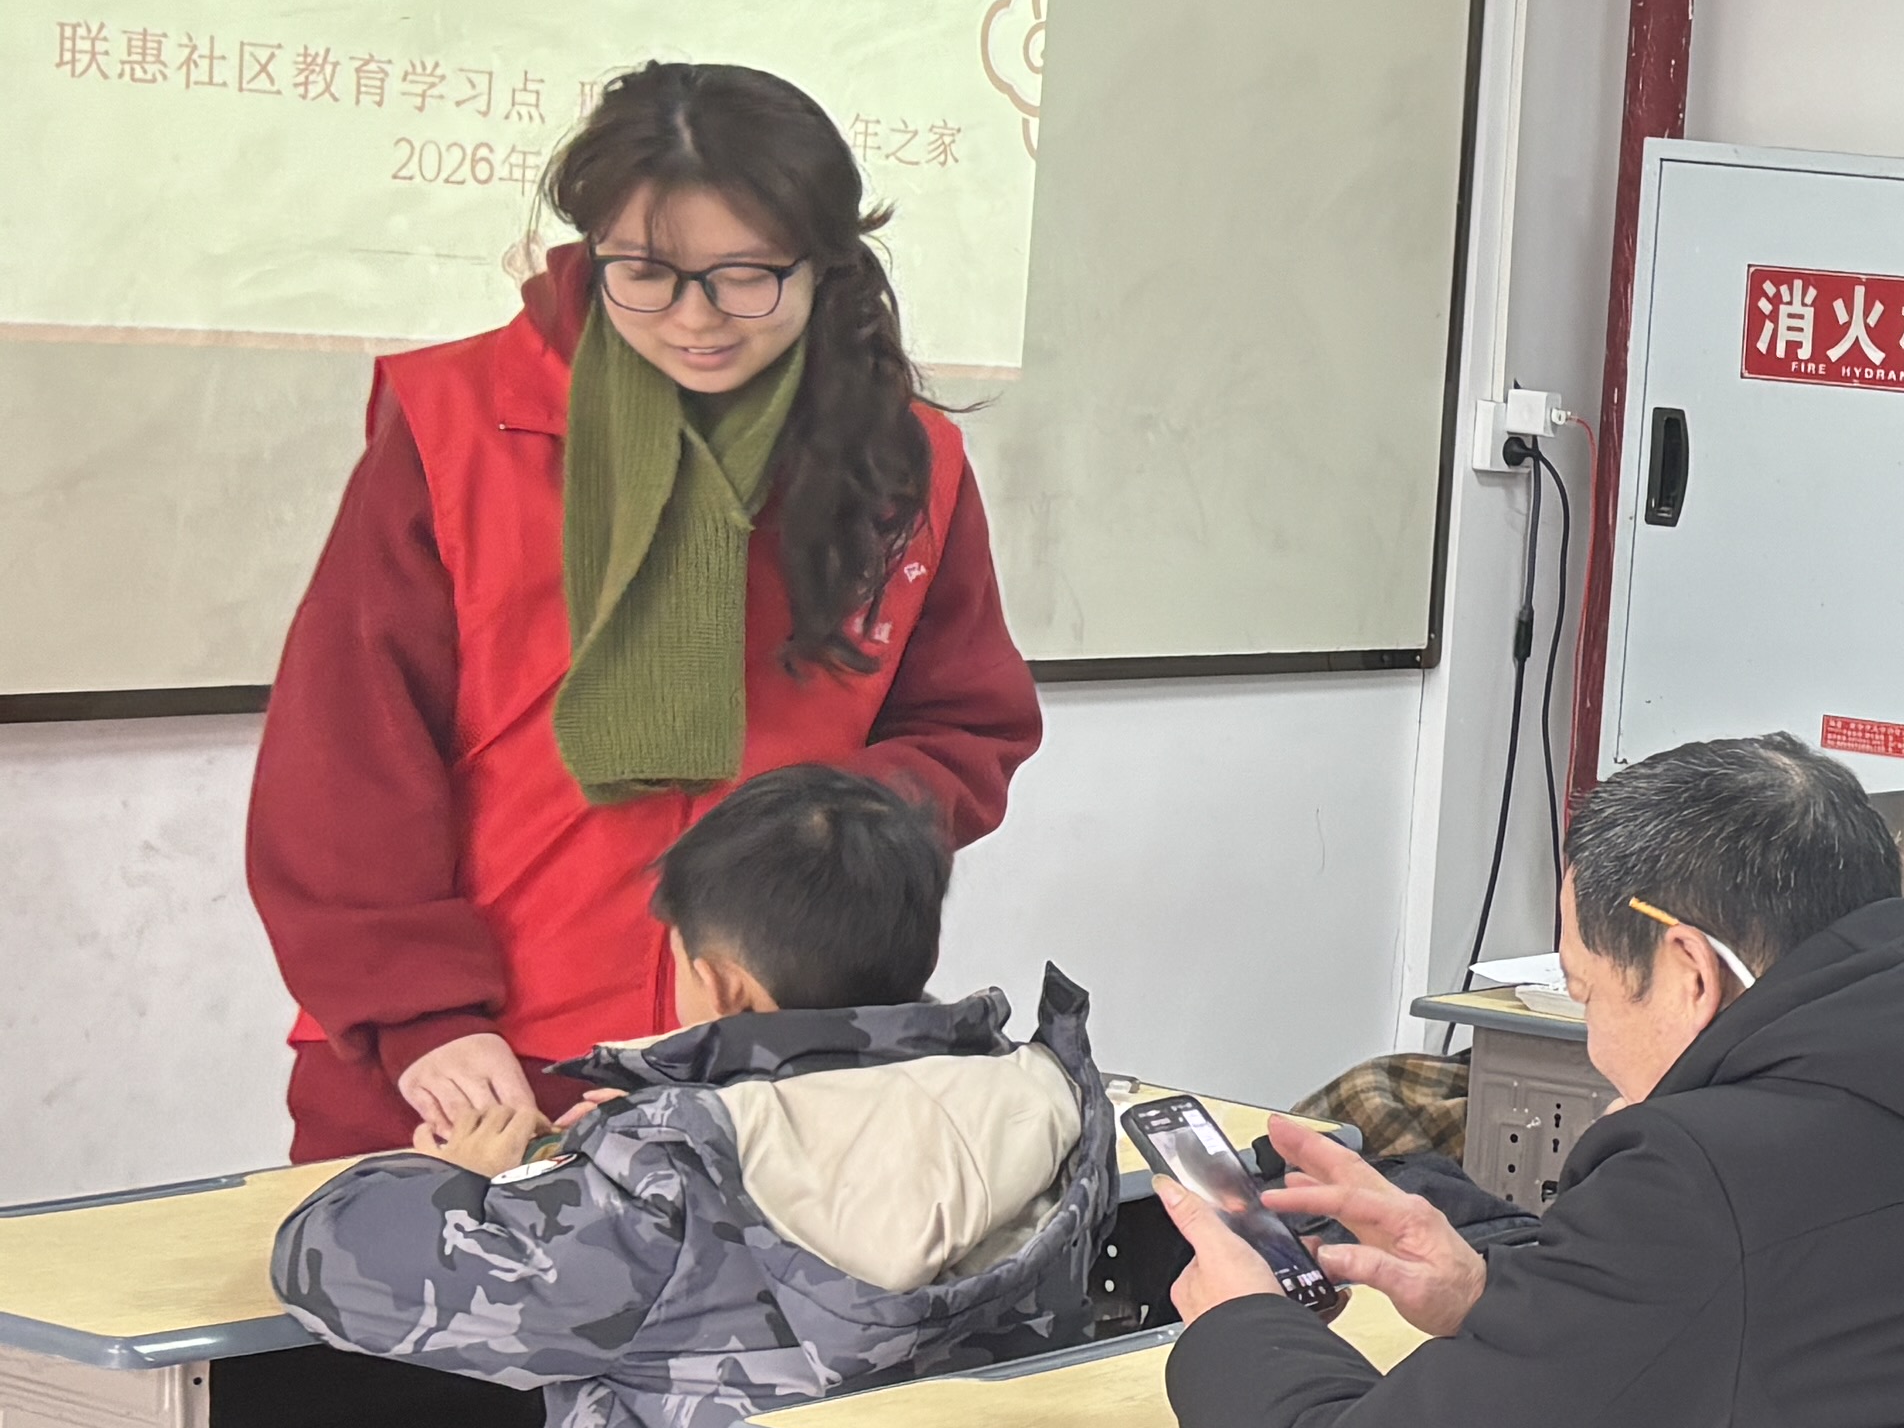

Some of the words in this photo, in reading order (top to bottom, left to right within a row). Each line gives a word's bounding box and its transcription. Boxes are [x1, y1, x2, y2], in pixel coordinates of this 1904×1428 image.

[55, 20, 546, 125] 联惠社区教育学习点
[1791, 361, 1826, 374] FIRE
